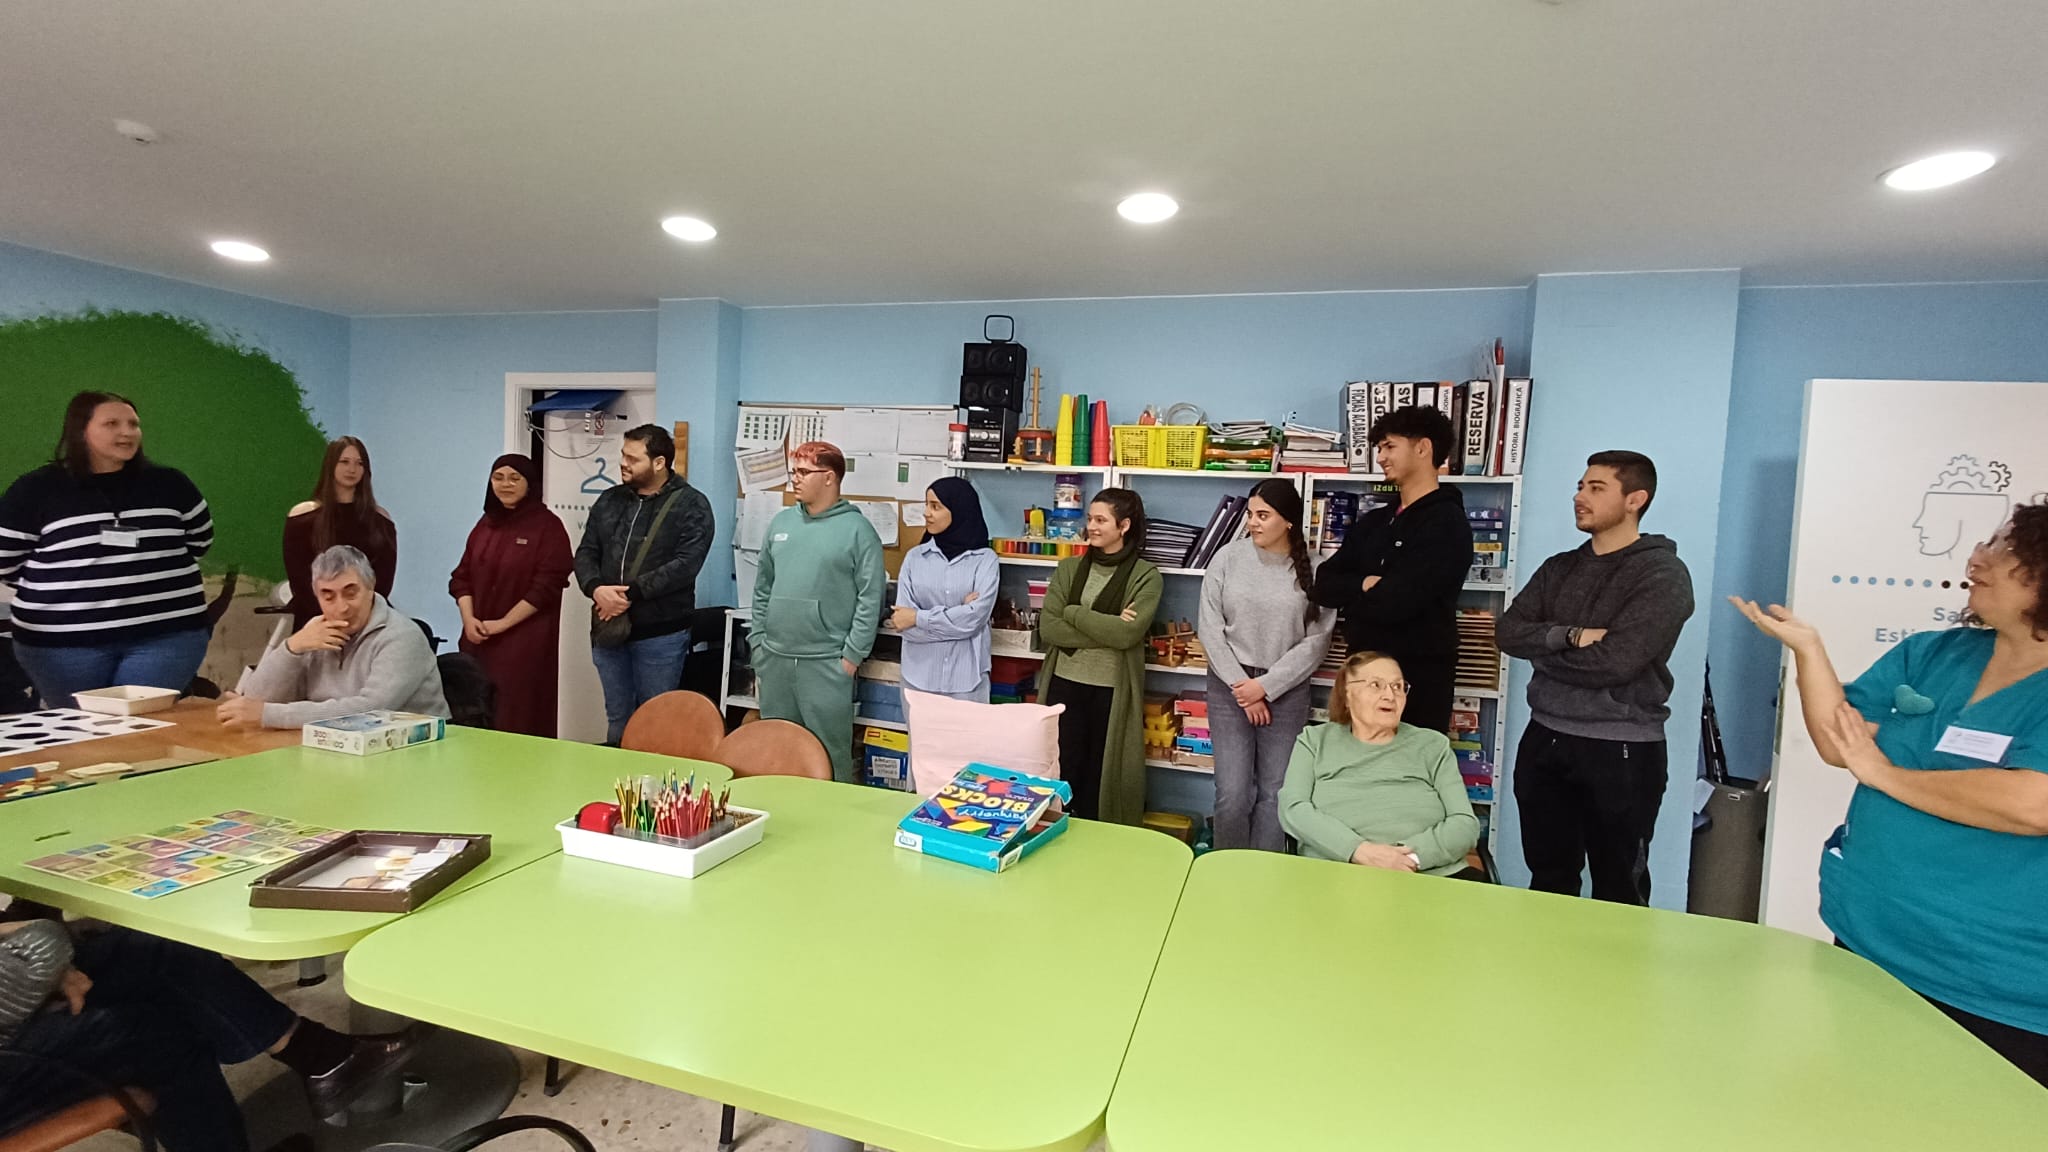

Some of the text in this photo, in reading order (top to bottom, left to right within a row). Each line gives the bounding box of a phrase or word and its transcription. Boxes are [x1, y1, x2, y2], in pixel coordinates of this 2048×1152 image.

[1398, 387, 1410, 406] AS
[1351, 388, 1367, 448] FICHAS ACABADAS
[1468, 391, 1485, 456] RESERVA
[1510, 431, 1519, 463] HISTORIA
[1932, 606, 1959, 623] Sa
[942, 784, 1031, 813] BLOCKS
